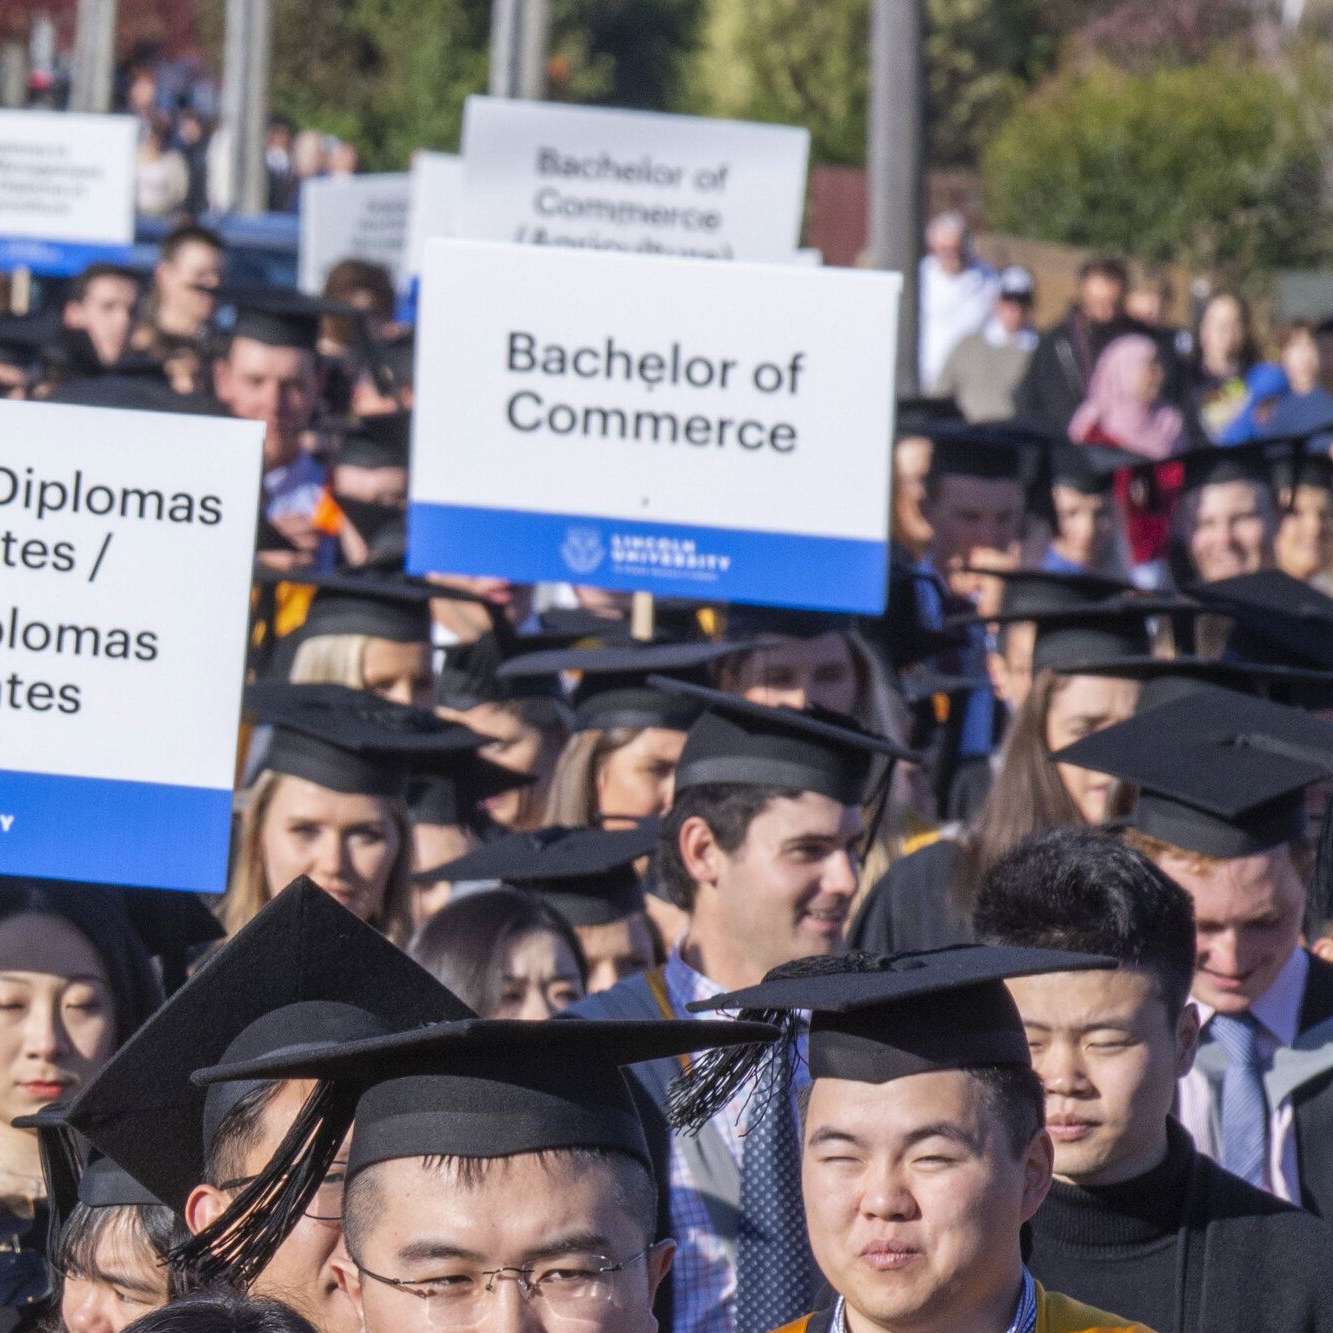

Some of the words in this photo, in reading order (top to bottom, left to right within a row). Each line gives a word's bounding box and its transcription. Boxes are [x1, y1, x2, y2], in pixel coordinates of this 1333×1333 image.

[534, 146, 682, 187] Bachelor
[693, 162, 729, 192] of
[533, 186, 722, 233] Commerce
[506, 331, 736, 390] Bachelor
[752, 352, 805, 395] of
[506, 389, 798, 454] Commerce
[87, 531, 113, 583] /
